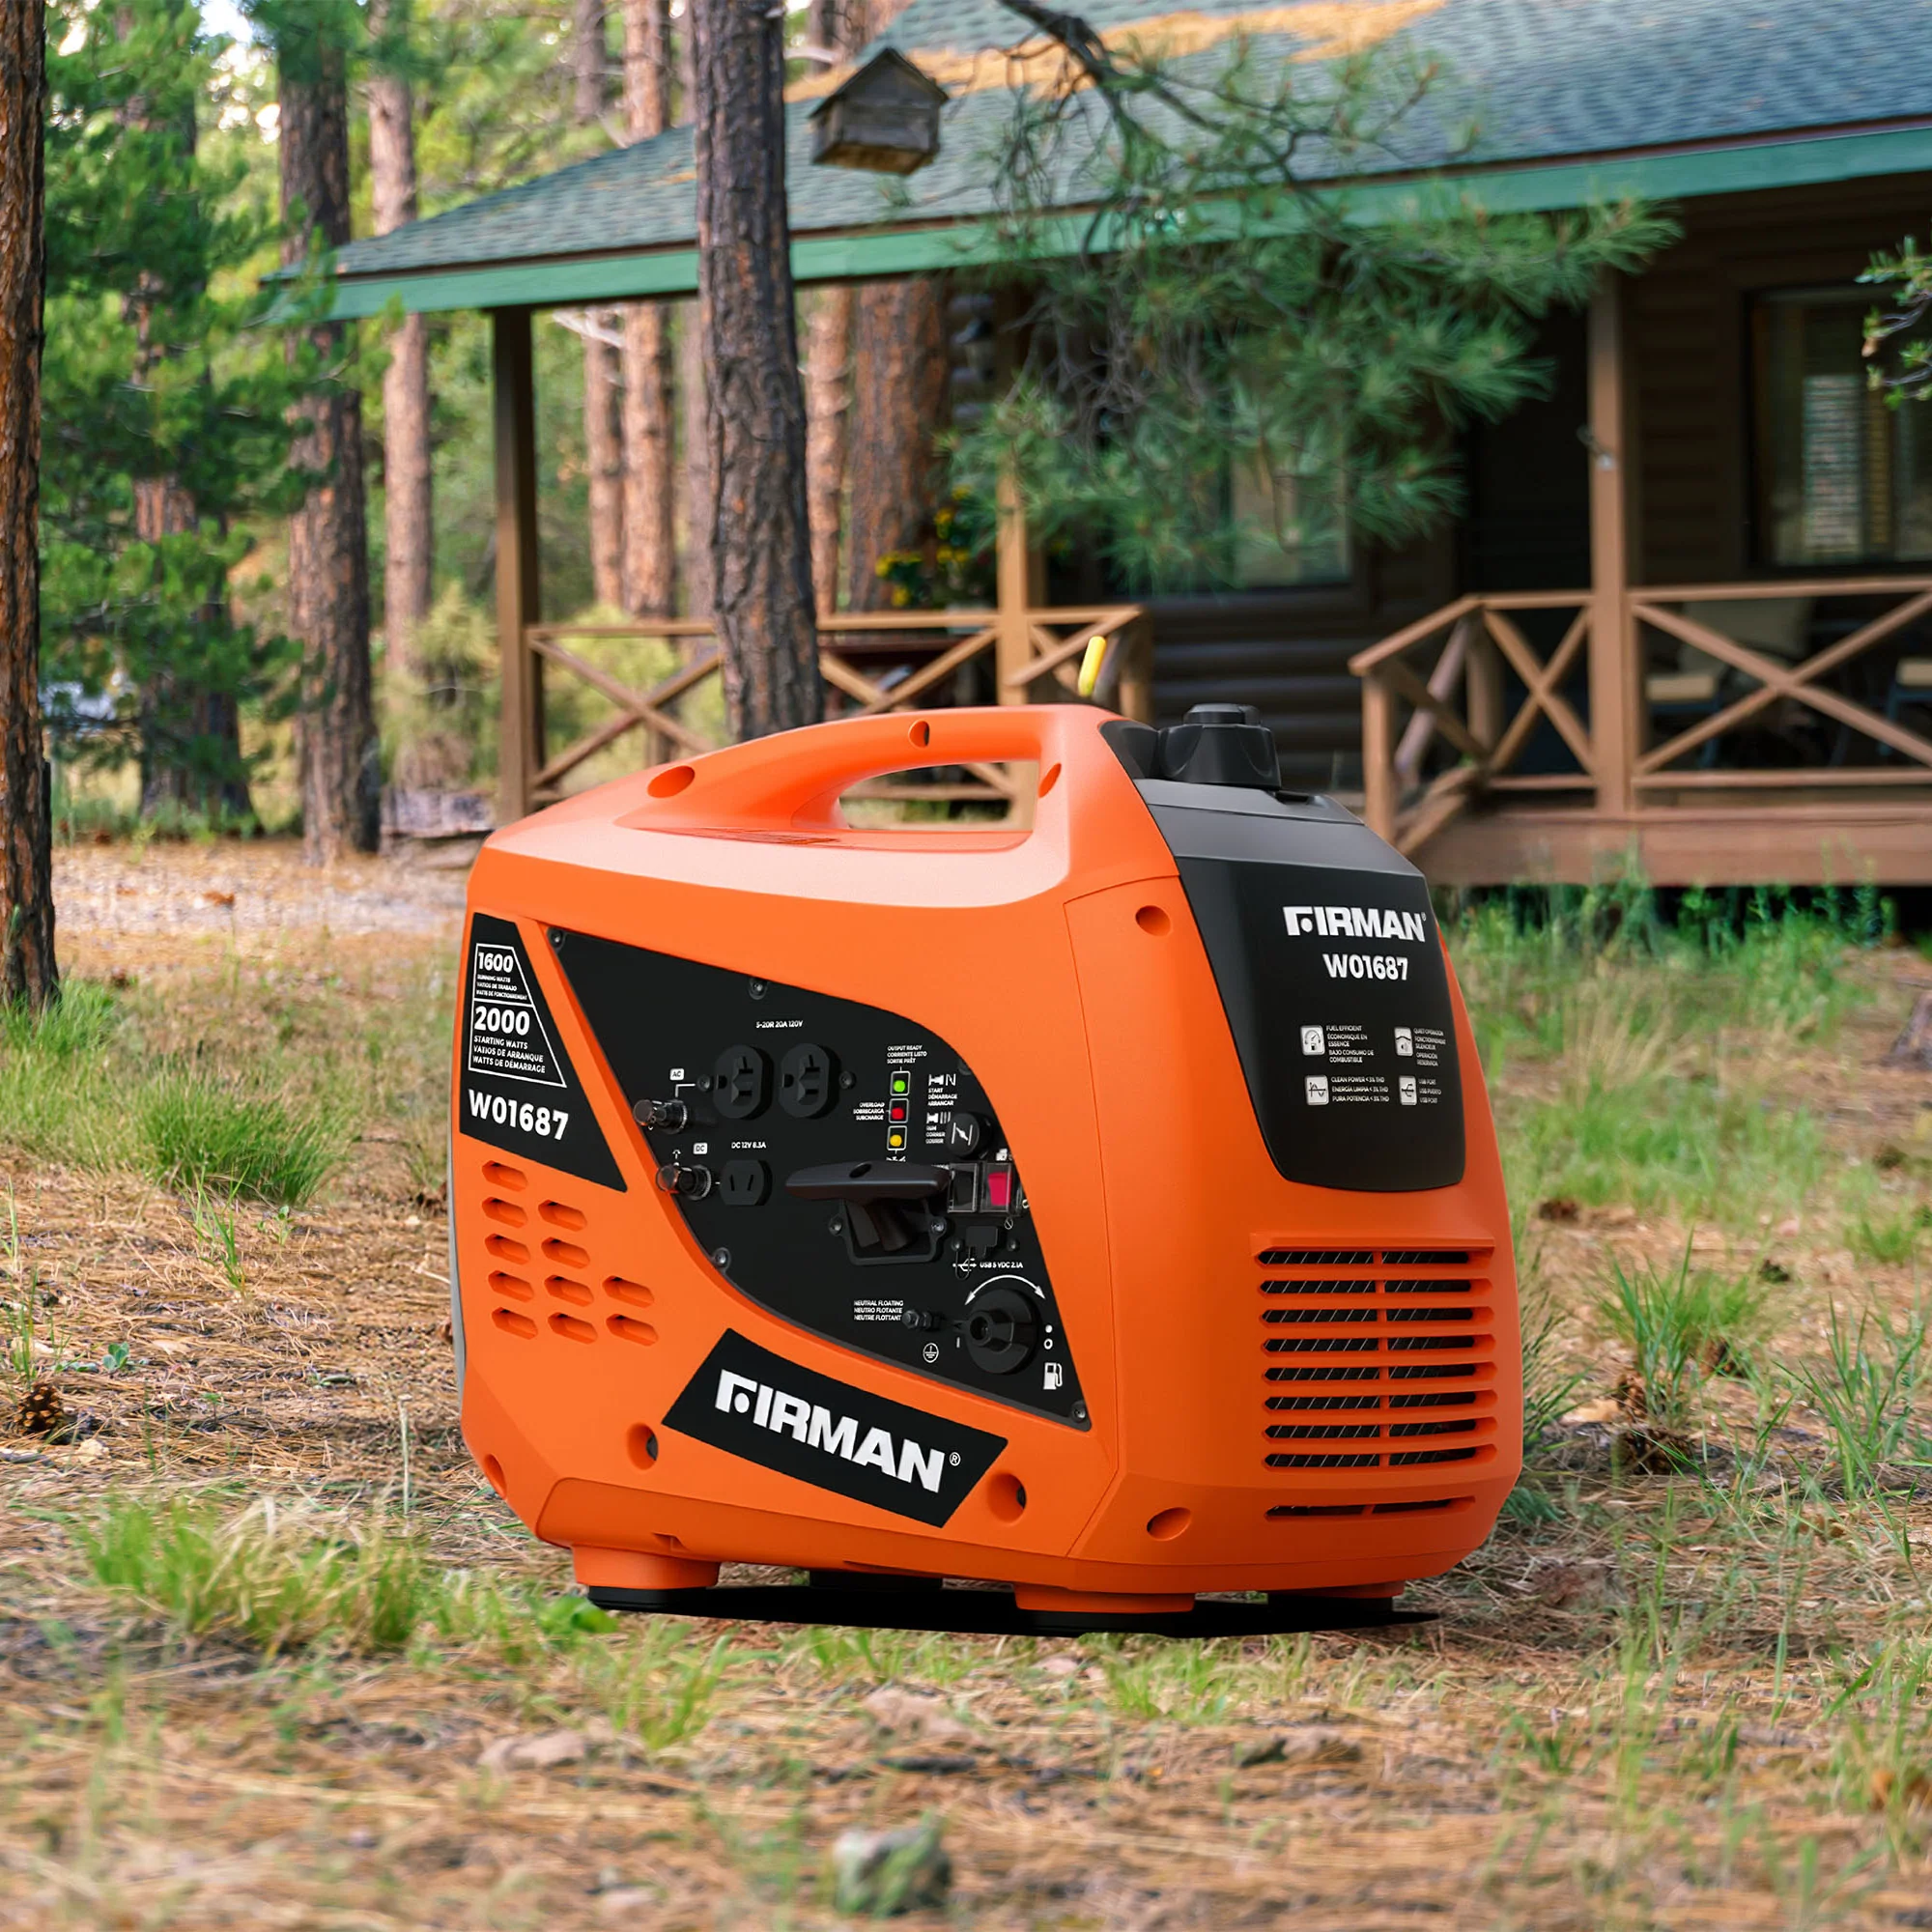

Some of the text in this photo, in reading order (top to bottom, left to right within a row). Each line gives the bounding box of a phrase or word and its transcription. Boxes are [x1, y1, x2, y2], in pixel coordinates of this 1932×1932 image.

[478, 952, 513, 973] 1600
[1322, 953, 1407, 980] W01687
[474, 1006, 530, 1035] 2000
[474, 1036, 528, 1049] STARTING WATTS
[473, 1056, 545, 1073] WATTS DE DÉMARRAGE
[474, 1045, 543, 1063] VATIOS DE ARRANQUE
[468, 1089, 568, 1140] W01687
